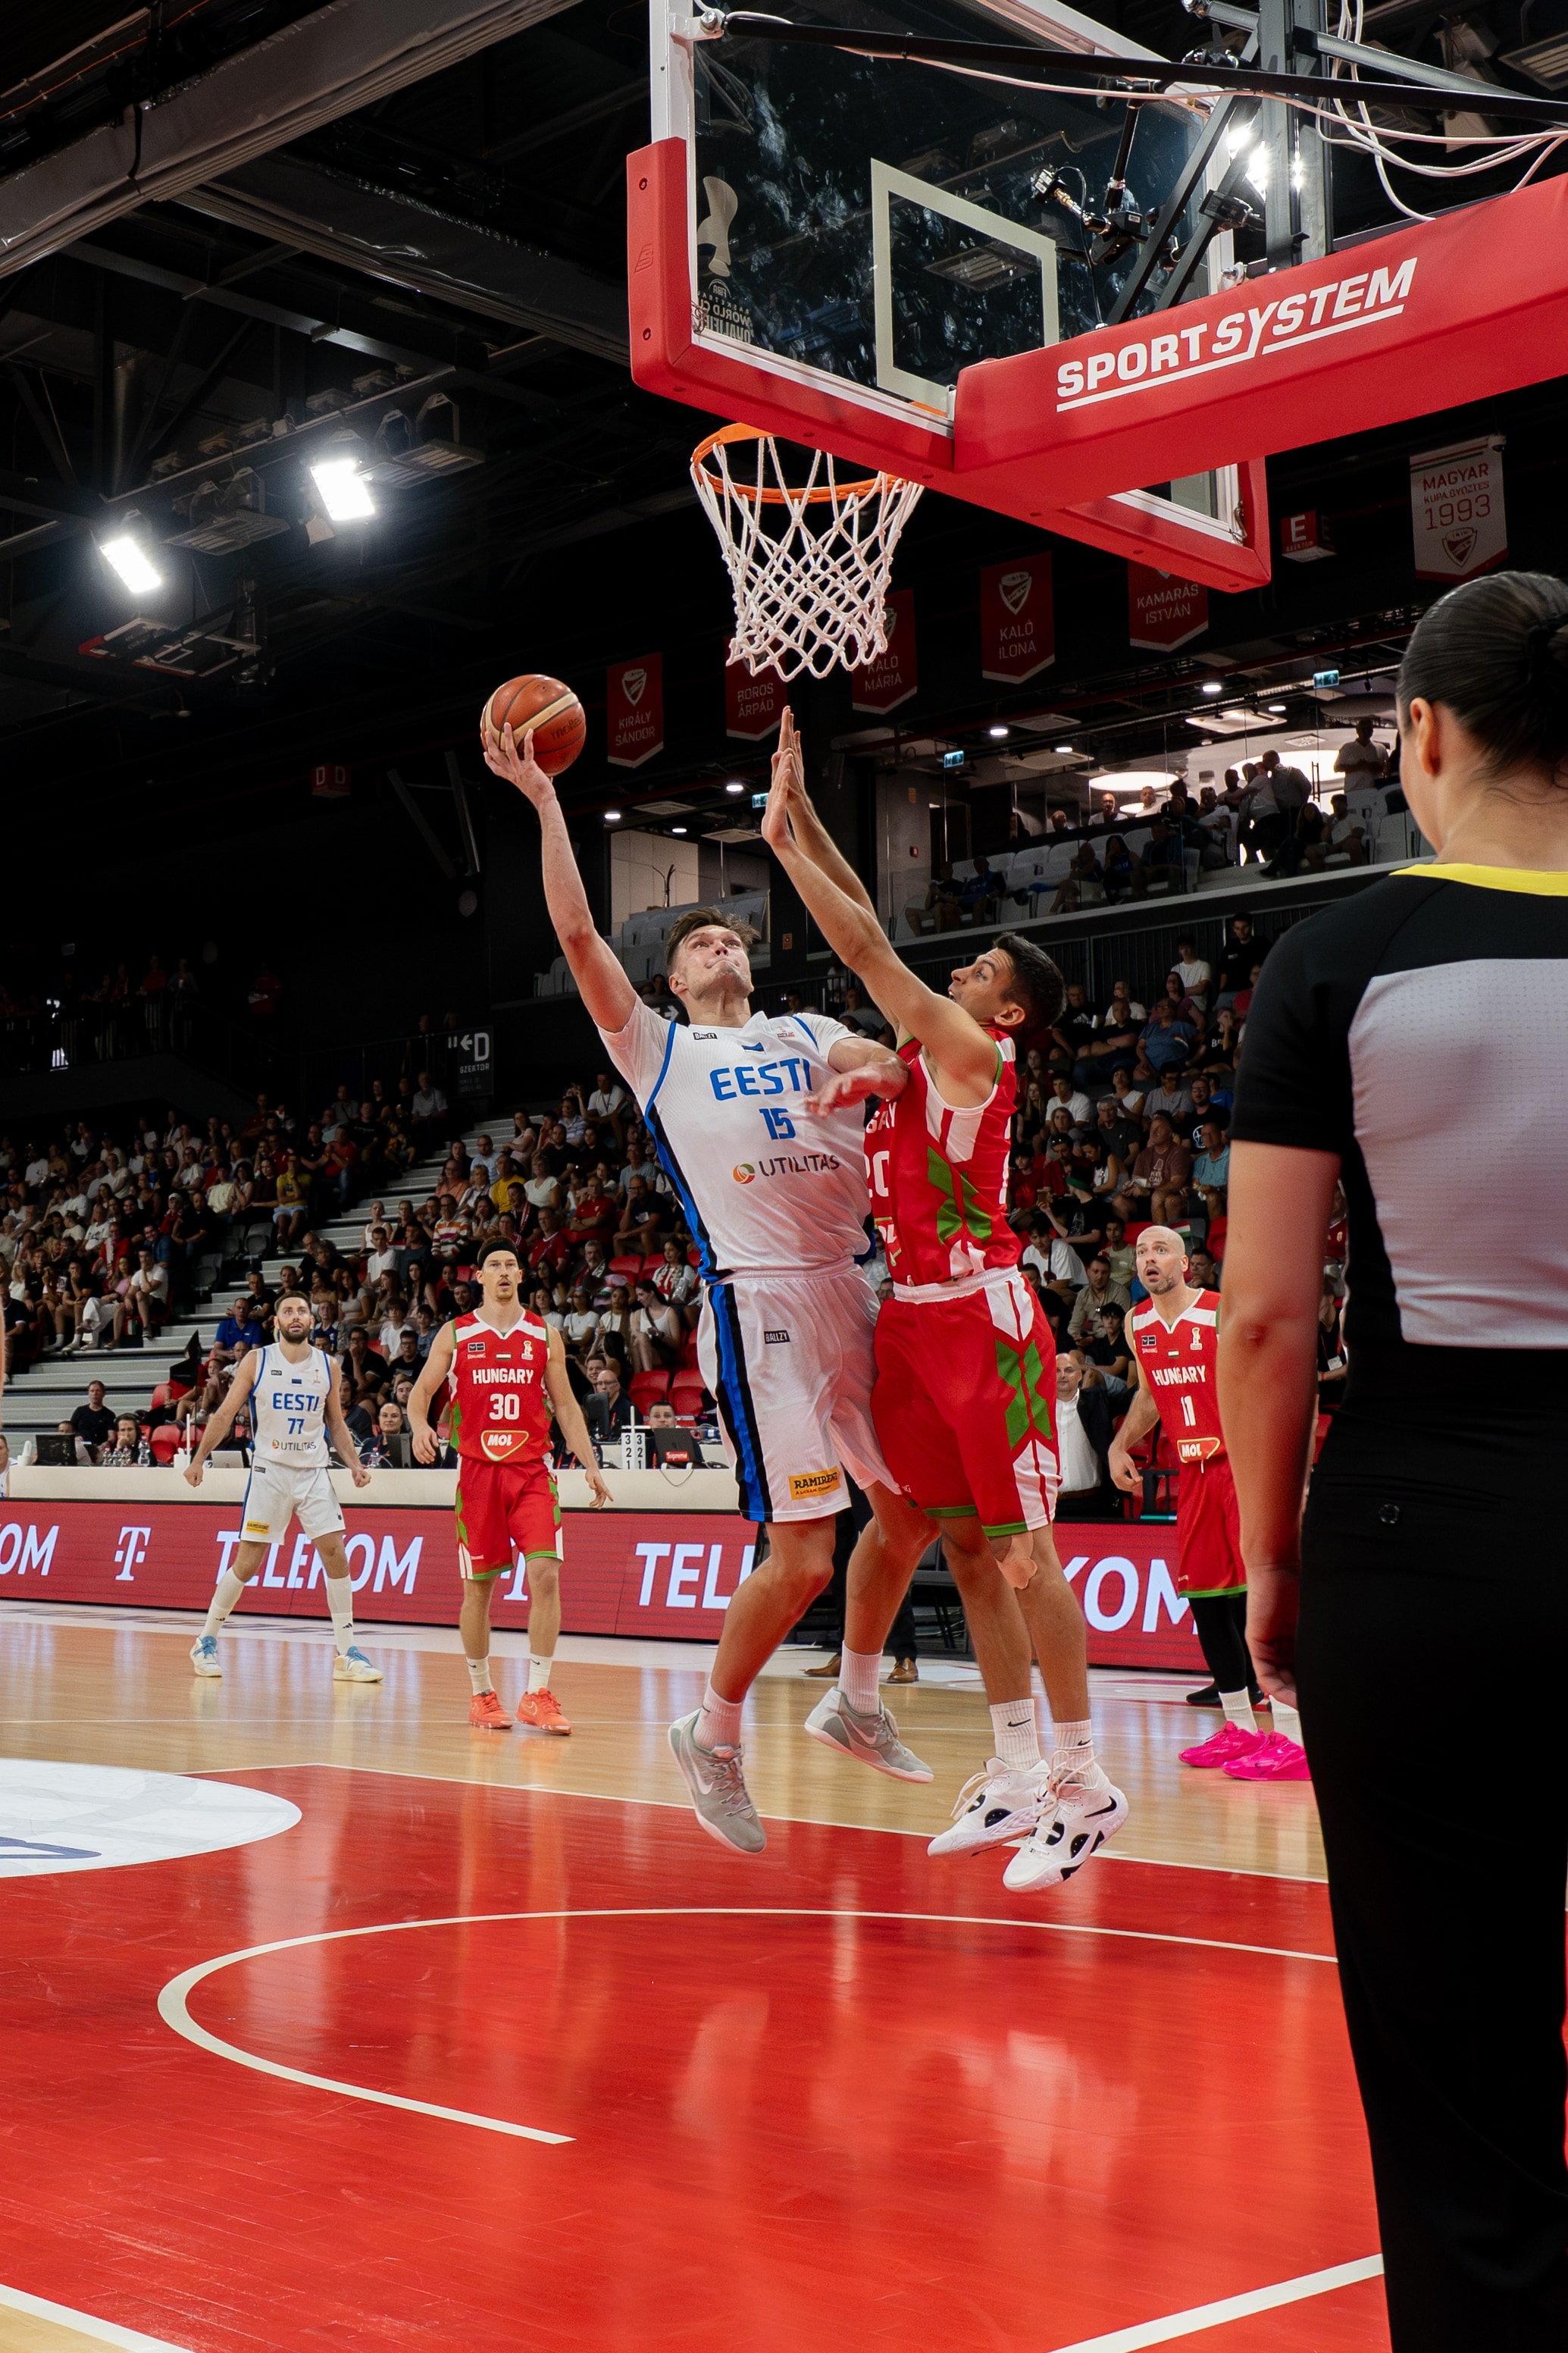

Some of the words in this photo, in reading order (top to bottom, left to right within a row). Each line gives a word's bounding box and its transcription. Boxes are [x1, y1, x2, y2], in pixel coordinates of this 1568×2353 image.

[1056, 323, 1208, 398] SPORT
[1211, 256, 1419, 356] SYSTEM
[1422, 462, 1490, 492] MAGYAR
[1425, 493, 1491, 531] 1993
[1291, 514, 1307, 543] E
[1137, 582, 1199, 610] KAMARÁS
[1145, 602, 1191, 625] ISTVÁN
[1000, 618, 1034, 642] KALÓ
[998, 639, 1038, 660] ILONA
[867, 653, 899, 675] KALÓ
[737, 682, 775, 703] BOROS
[864, 672, 903, 693] MÁRIA
[737, 697, 775, 719] ÁRPÁD
[618, 710, 652, 730] KIRÁLY
[615, 725, 656, 747] SÁNDOR
[474, 1032, 490, 1062] D
[459, 1062, 490, 1074] SZEKTOR
[709, 1057, 813, 1101] EESTI
[759, 1108, 797, 1140] 15
[759, 1153, 840, 1177] UTILITAS
[765, 1331, 788, 1343] BALLZY
[472, 1368, 534, 1385] HUNGARY
[1151, 1364, 1207, 1386] HUNGARY
[272, 1393, 320, 1412] EESTI
[489, 1393, 520, 1421] 30
[1180, 1395, 1197, 1427] 11
[287, 1418, 305, 1435] 77
[280, 1441, 318, 1452] UTILITAS
[487, 1433, 513, 1446] MOL
[624, 1434, 631, 1445] 3
[637, 1434, 643, 1445] 3
[1181, 1443, 1203, 1458] MOL
[625, 1447, 632, 1458] 2
[637, 1447, 643, 1458] 2
